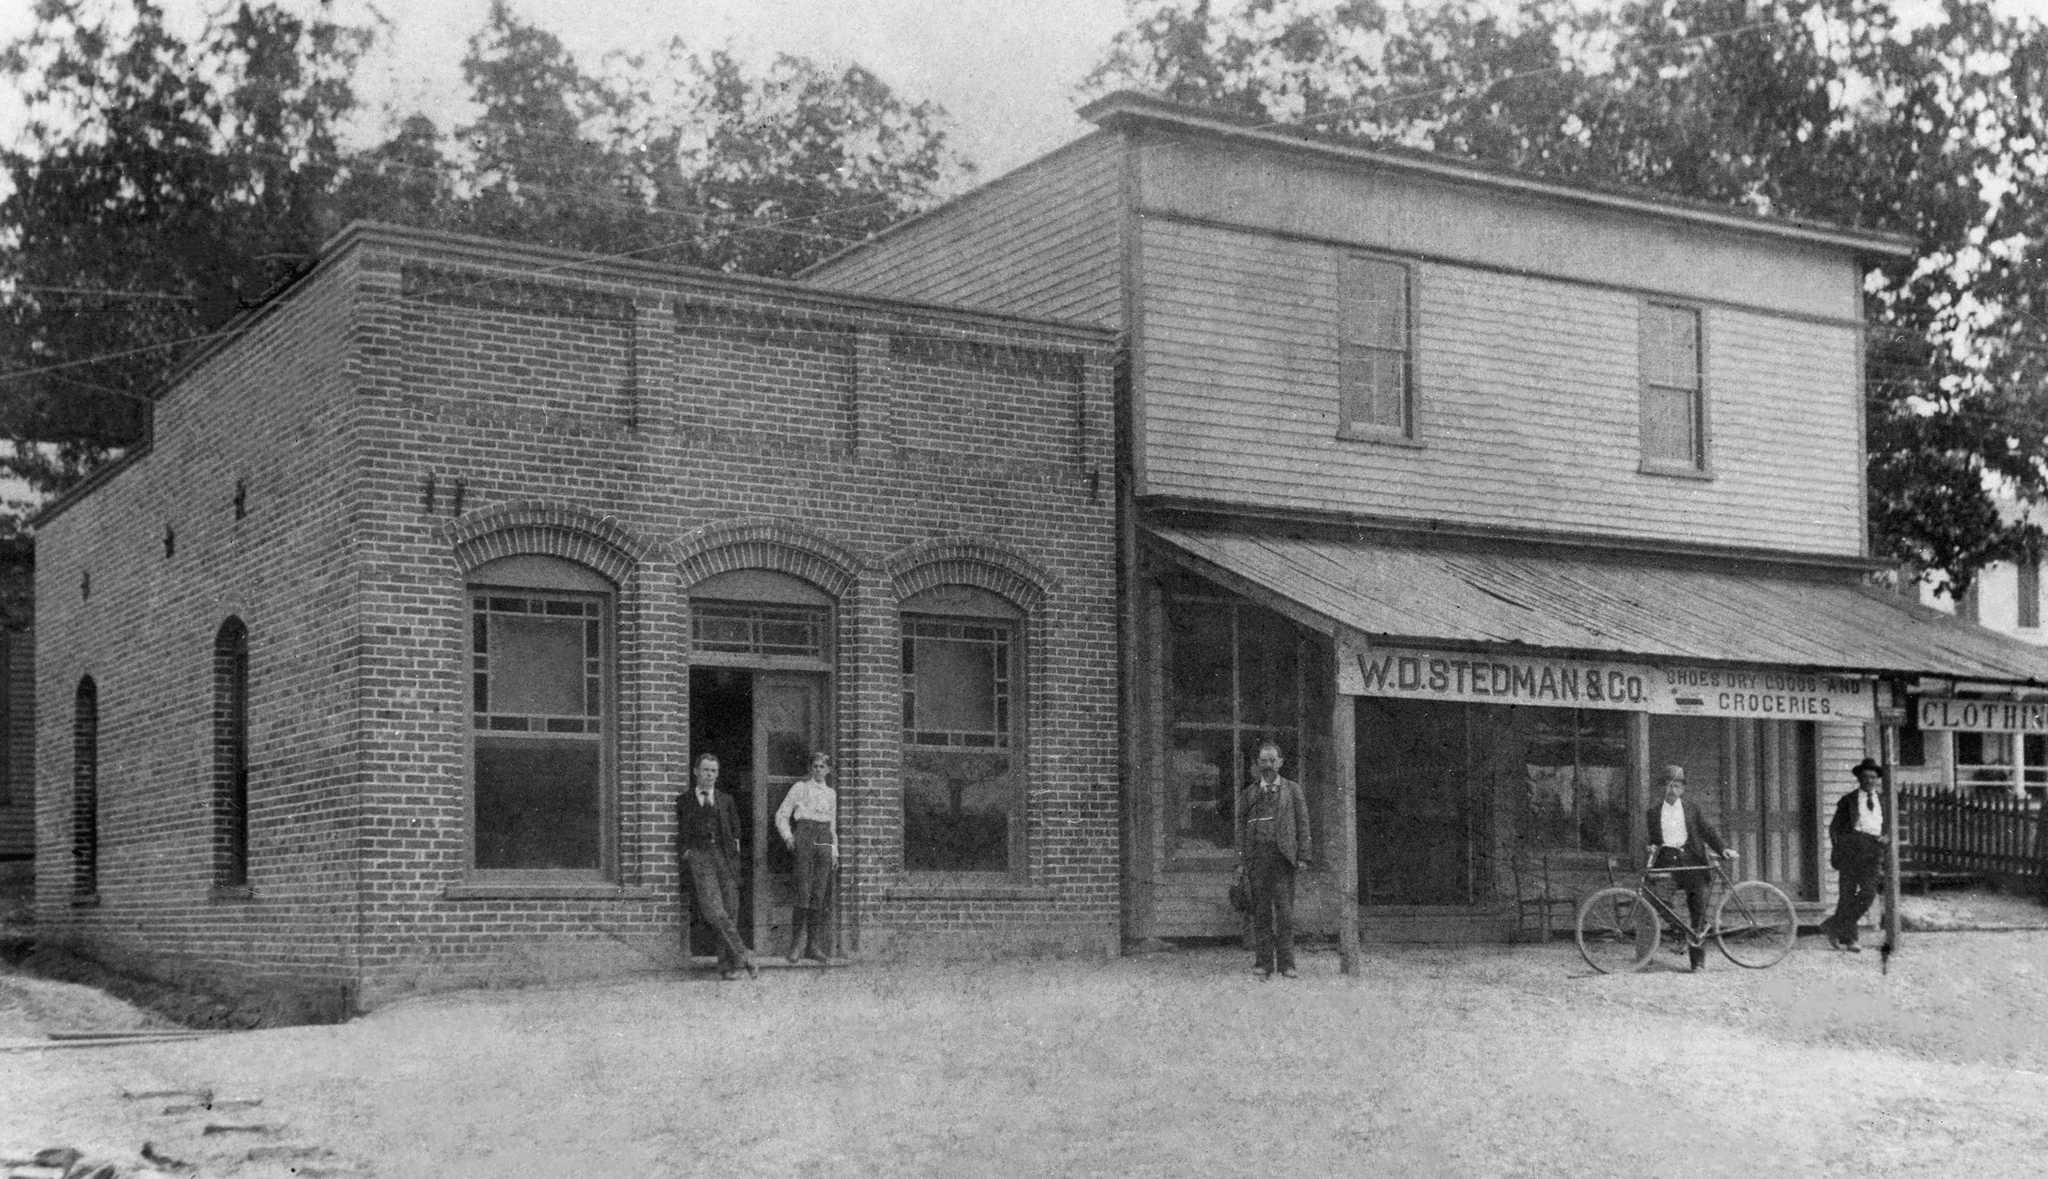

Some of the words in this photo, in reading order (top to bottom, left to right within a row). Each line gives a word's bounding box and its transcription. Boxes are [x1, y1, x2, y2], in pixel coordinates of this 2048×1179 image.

[1667, 669, 1720, 687] SHOES
[1727, 672, 1757, 690] DRY
[1827, 678, 1860, 695] AND
[1922, 701, 2048, 730] CLOTHIN
